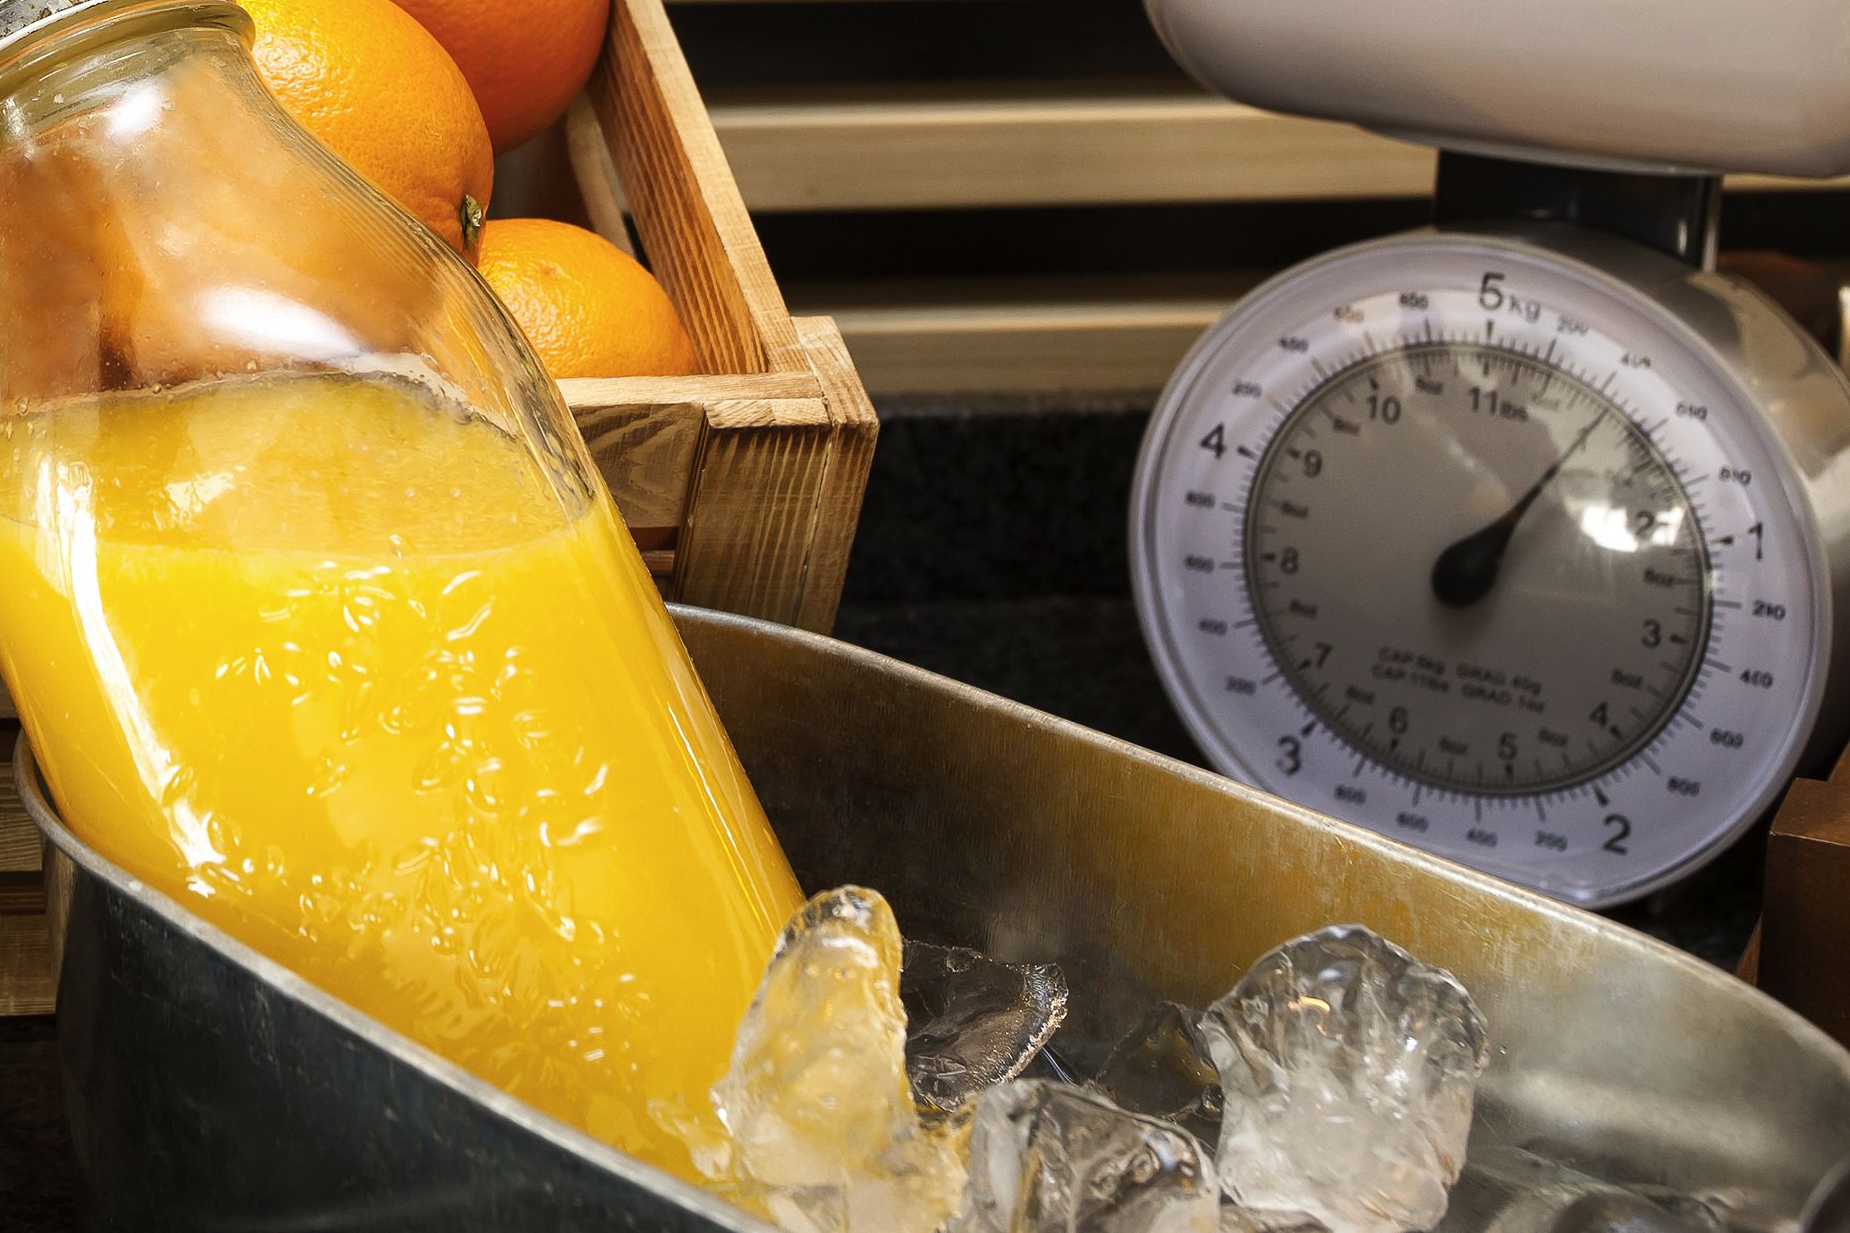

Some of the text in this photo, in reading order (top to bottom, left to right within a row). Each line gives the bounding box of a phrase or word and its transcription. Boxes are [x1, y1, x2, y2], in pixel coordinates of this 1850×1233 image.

[1366, 394, 1402, 426] 10
[1200, 421, 1227, 461] 4
[1304, 449, 1323, 478] 9
[1748, 522, 1765, 561] 1
[1280, 546, 1299, 576] 8
[1641, 619, 1662, 649] 3
[1316, 641, 1334, 668] 7
[1388, 705, 1409, 735] 6
[1589, 701, 1609, 727] 4
[1275, 734, 1302, 777] 3
[1497, 731, 1518, 761] 5
[1603, 813, 1632, 855] 2
